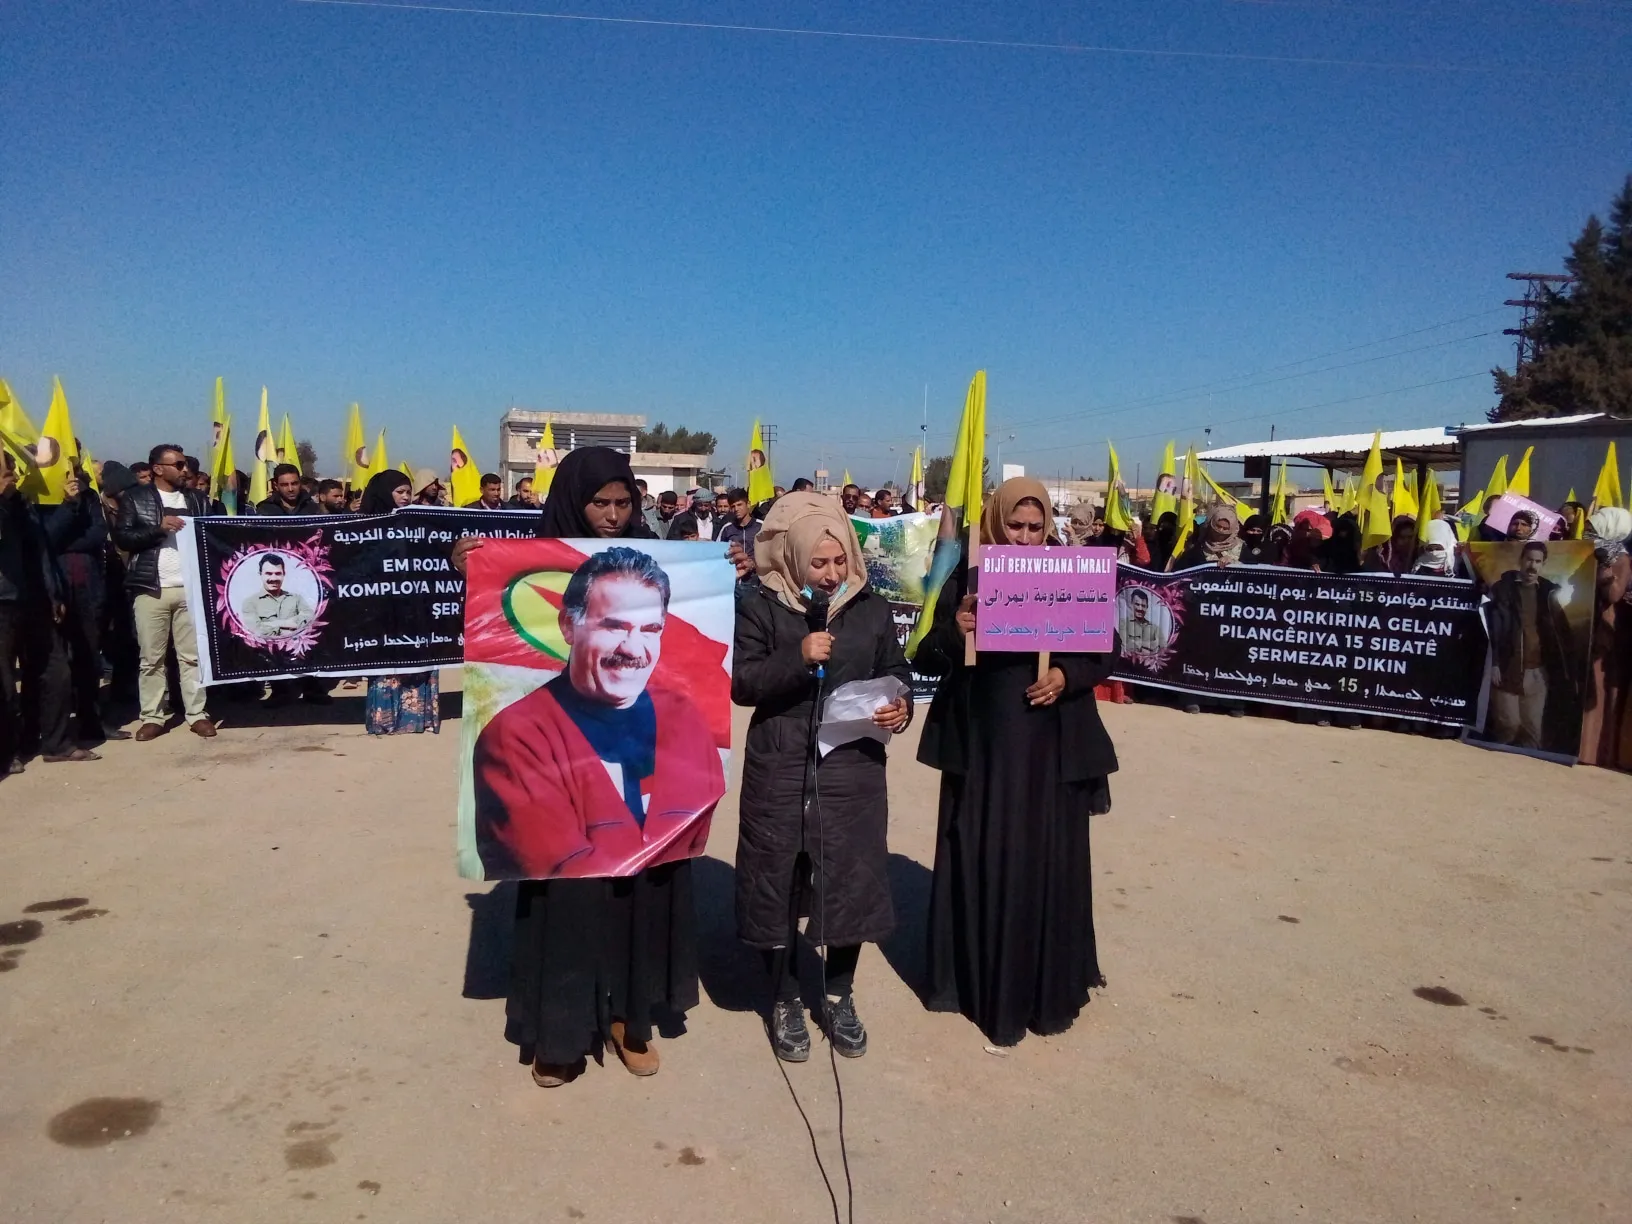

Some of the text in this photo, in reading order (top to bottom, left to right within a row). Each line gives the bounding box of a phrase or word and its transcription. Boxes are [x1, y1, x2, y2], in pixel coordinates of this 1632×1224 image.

[334, 528, 382, 545] الكردية
[387, 527, 425, 543] الإبادة
[428, 531, 452, 543] يوم
[383, 559, 409, 572] EM
[413, 558, 449, 572] ROJA
[984, 555, 1111, 574] BIJÎ BERXWEDANA ÎMRALI
[338, 581, 430, 598] KOMPLOYA
[1190, 580, 1243, 594] الشعوب
[1247, 583, 1277, 600] إبادة
[1280, 587, 1306, 600] يوم
[1034, 588, 1072, 607] مقاومة
[1359, 590, 1374, 602] 15
[1378, 592, 1427, 608] مؤامرة
[432, 602, 461, 619] ŞER
[1200, 603, 1225, 617] EM
[1231, 605, 1277, 621] ROJA
[1388, 617, 1453, 636] GELAN
[1220, 624, 1438, 656] PILANGÊRIYA 15 SIBATÊ
[1248, 646, 1407, 674] ŞERMEZAR DIKIN
[1338, 677, 1358, 693] 15
